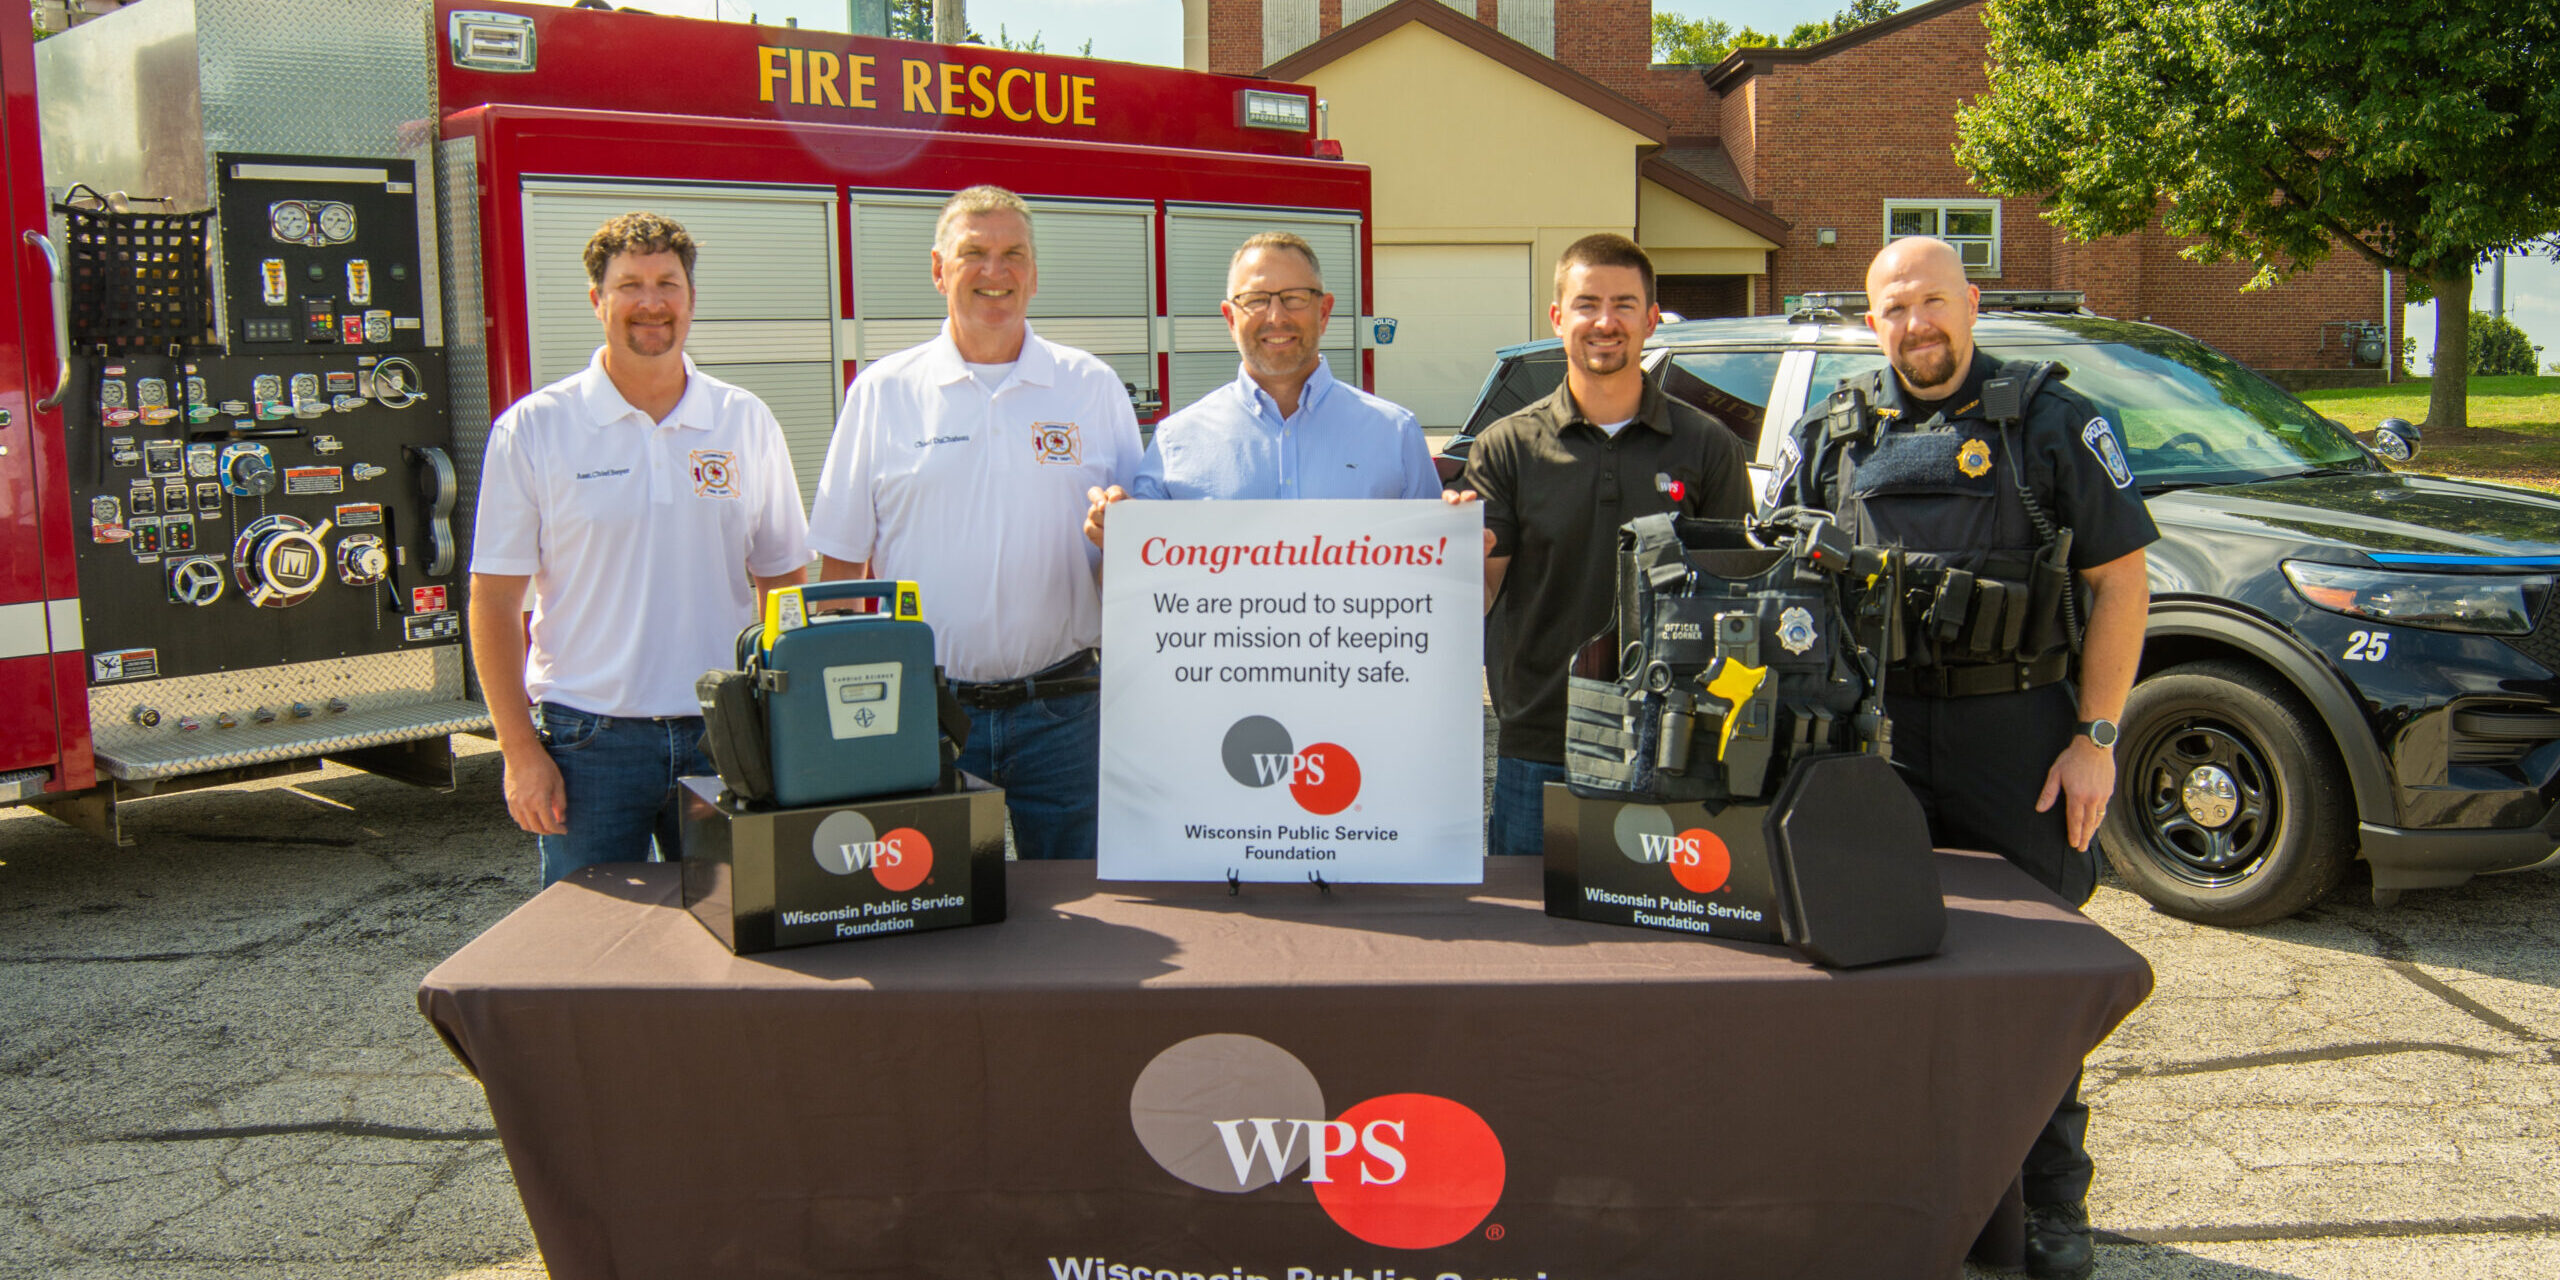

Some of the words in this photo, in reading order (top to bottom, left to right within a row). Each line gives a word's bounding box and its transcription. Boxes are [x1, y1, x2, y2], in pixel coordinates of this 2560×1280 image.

[758, 45, 877, 109] FIRE
[902, 57, 1097, 127] RESCUE
[1141, 535, 1448, 574] Congratulations!
[1153, 593, 1189, 614] We
[1196, 598, 1232, 614] are
[1240, 592, 1307, 618] proud
[1314, 595, 1336, 614] to
[1343, 594, 1433, 618] support
[1156, 631, 1207, 653] your
[1214, 626, 1300, 648] mission
[1309, 626, 1332, 648] of
[1338, 626, 1429, 653] keeping
[1664, 623, 1700, 632] OFFICER
[2343, 630, 2390, 662] 25
[1175, 665, 1213, 682] our
[1220, 661, 1350, 687] community
[1357, 661, 1409, 682] safe.
[1252, 753, 1325, 786] WPS
[1185, 825, 1272, 840] Wisconsin
[1278, 825, 1329, 840] Public
[1335, 825, 1398, 841] Service
[840, 838, 902, 871] WPS
[1245, 846, 1336, 860] Foundation
[1639, 833, 1700, 866] WPS
[783, 905, 859, 925] Wisconsin
[863, 900, 907, 917] Public
[911, 894, 964, 910] Service
[1585, 887, 1656, 908] Wisconsin
[1660, 896, 1704, 914] Public
[1708, 902, 1762, 921] Service
[836, 917, 914, 937] Foundation
[1633, 910, 1709, 932] Foundation
[1213, 1117, 1407, 1186] WPS
[1048, 1257, 1270, 1280] Wisco
